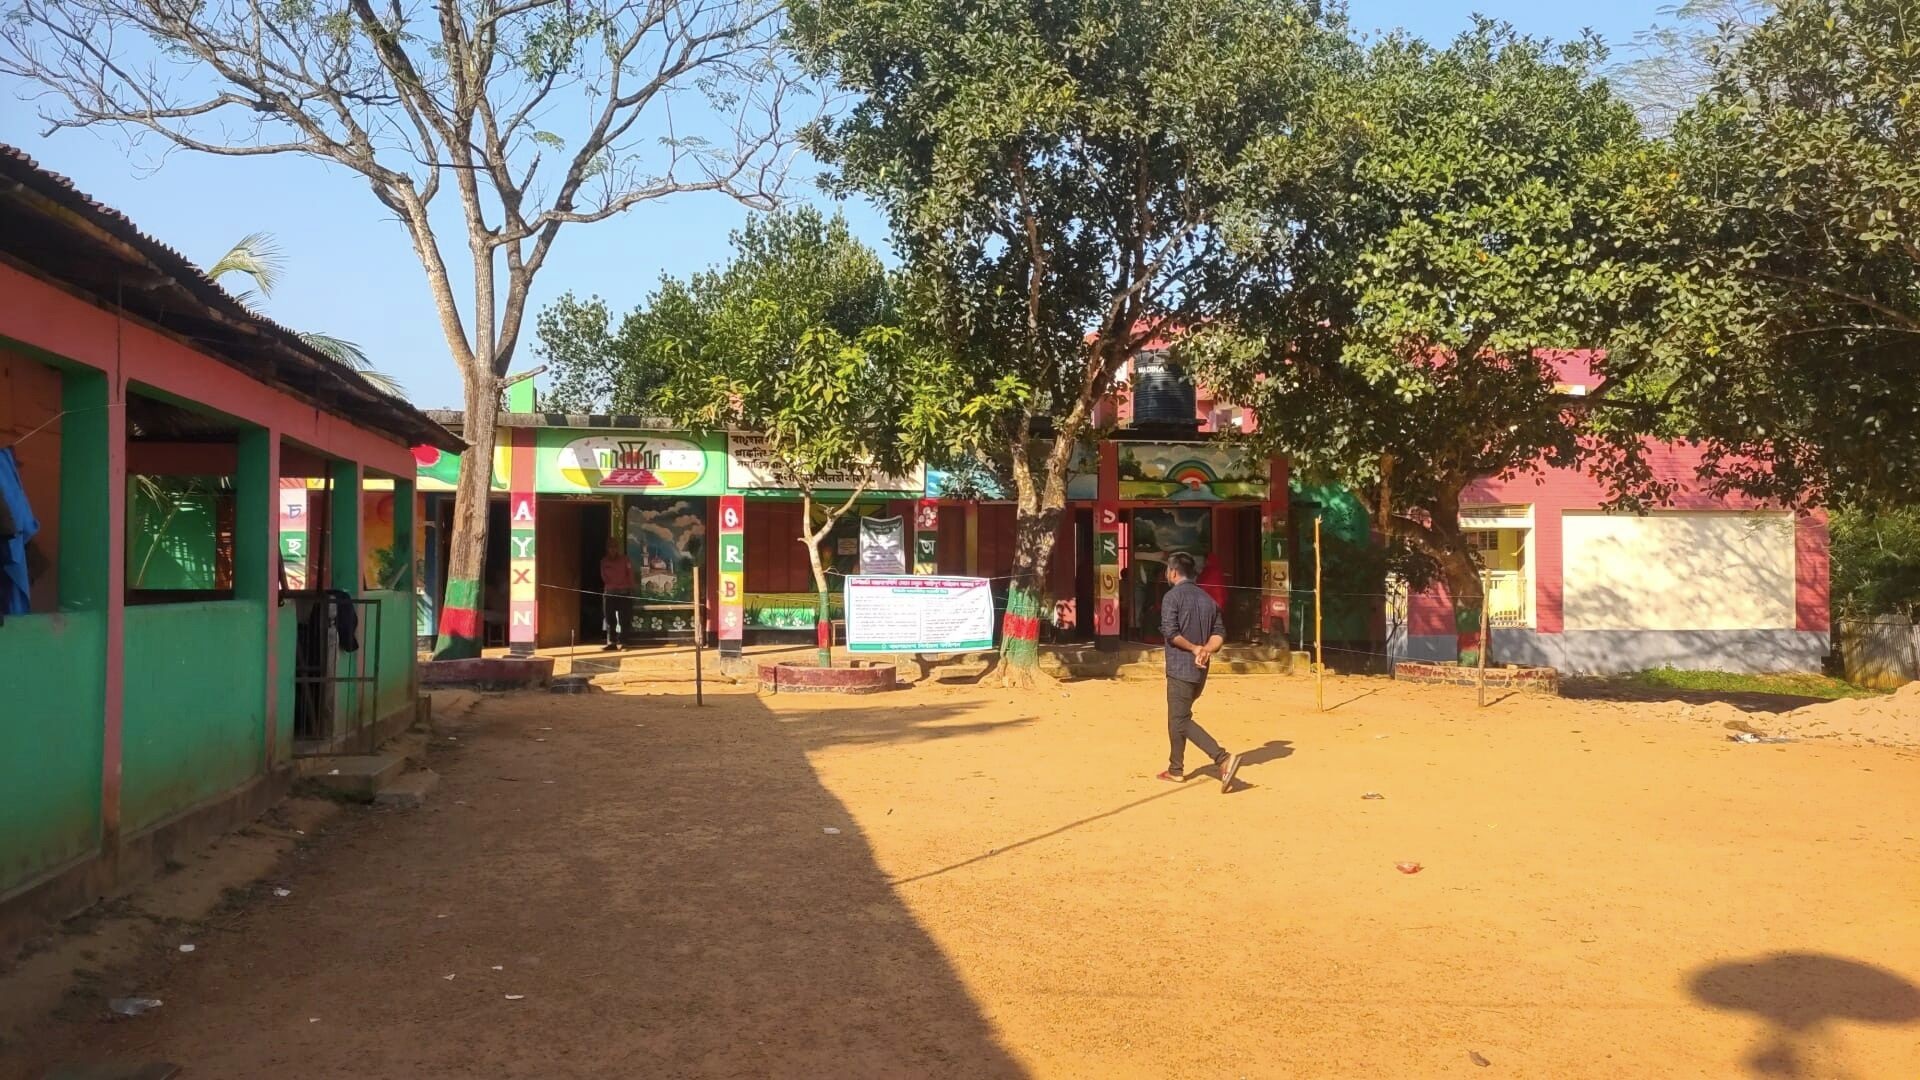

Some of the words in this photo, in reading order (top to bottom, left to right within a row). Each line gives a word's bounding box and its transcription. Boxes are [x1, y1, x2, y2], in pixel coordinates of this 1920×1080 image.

[287, 504, 302, 518] চ
[513, 501, 533, 521] A
[1103, 509, 1116, 524] ১
[286, 538, 302, 556] ছ
[511, 537, 533, 558] Y
[726, 545, 742, 563] R
[919, 539, 936, 555] অ
[1103, 538, 1117, 557] ২
[513, 568, 531, 585] X
[1102, 572, 1114, 590] ৩
[725, 581, 736, 598] B
[513, 610, 532, 626] N
